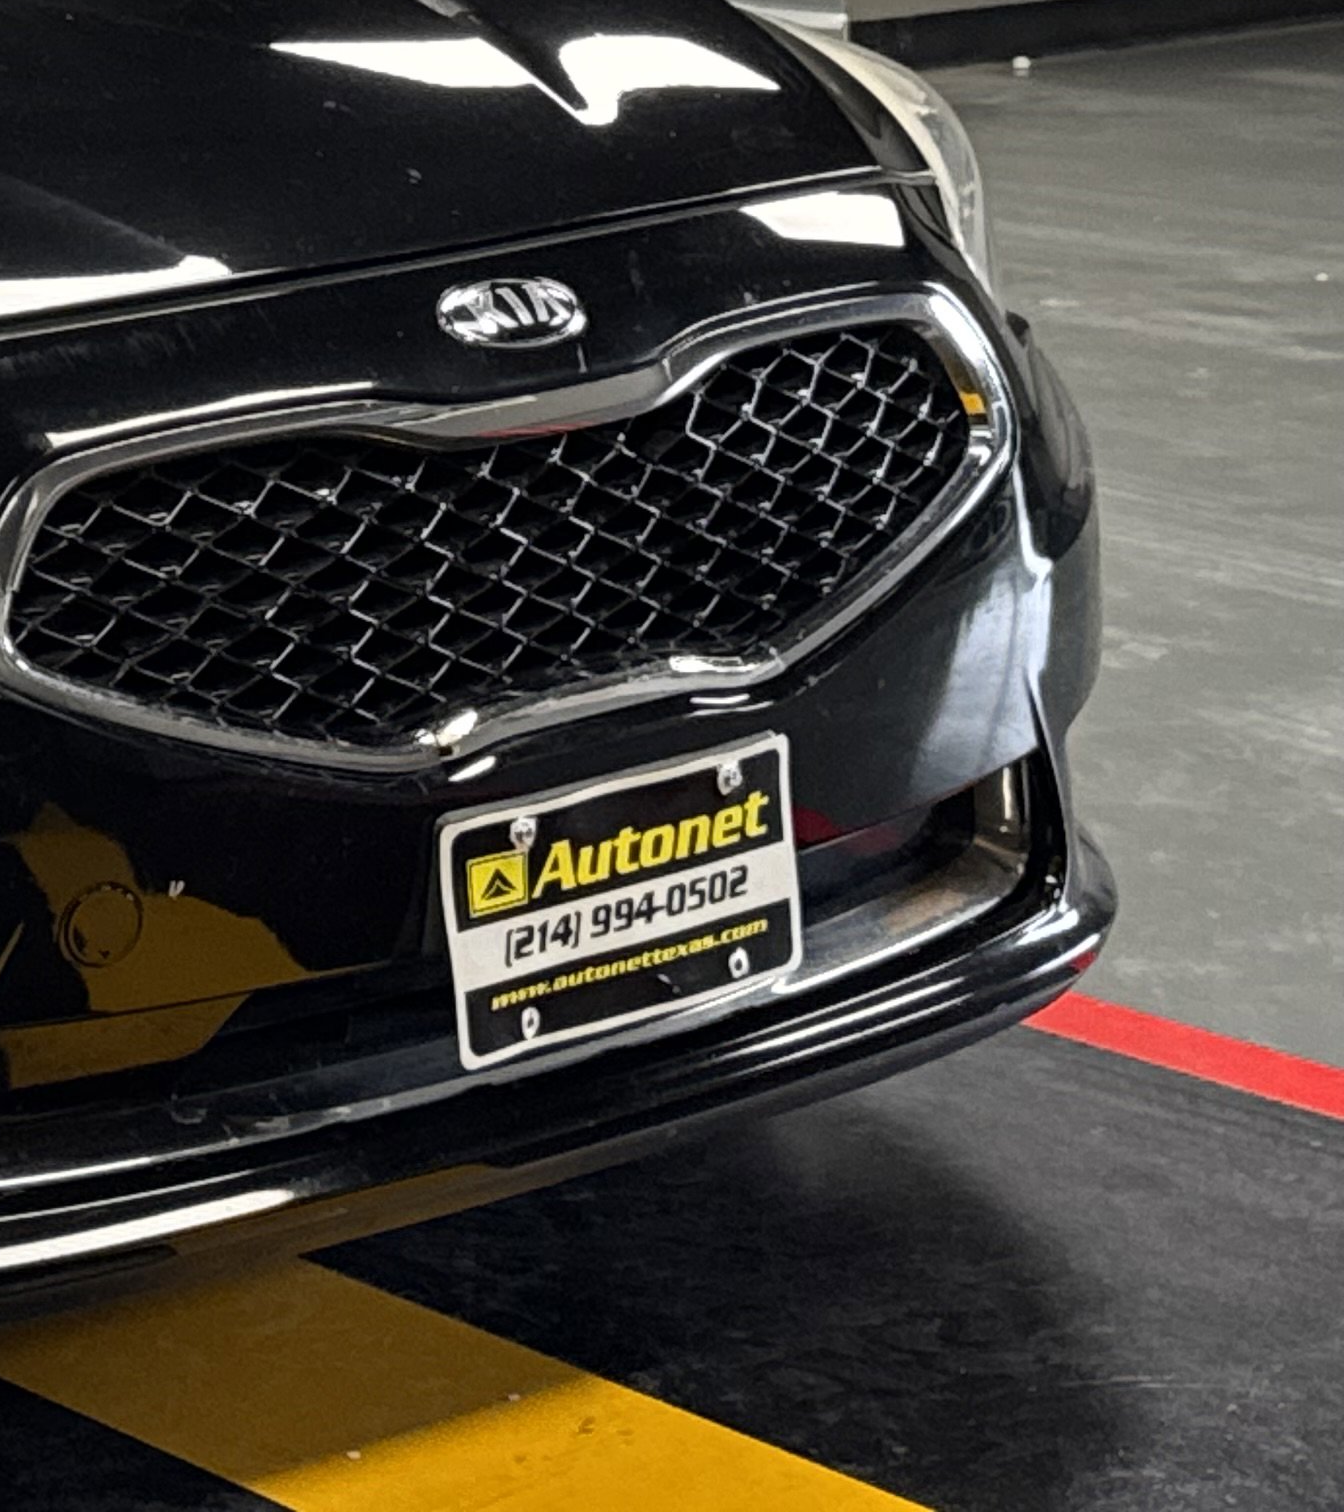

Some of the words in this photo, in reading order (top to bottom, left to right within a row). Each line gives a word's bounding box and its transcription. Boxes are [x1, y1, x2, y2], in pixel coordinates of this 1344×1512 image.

[454, 282, 574, 336] KIA
[532, 790, 769, 899] Autonet
[491, 918, 769, 1011] www.autonettexas.com
[505, 911, 582, 968] (214)
[590, 864, 748, 939] 994-0502
